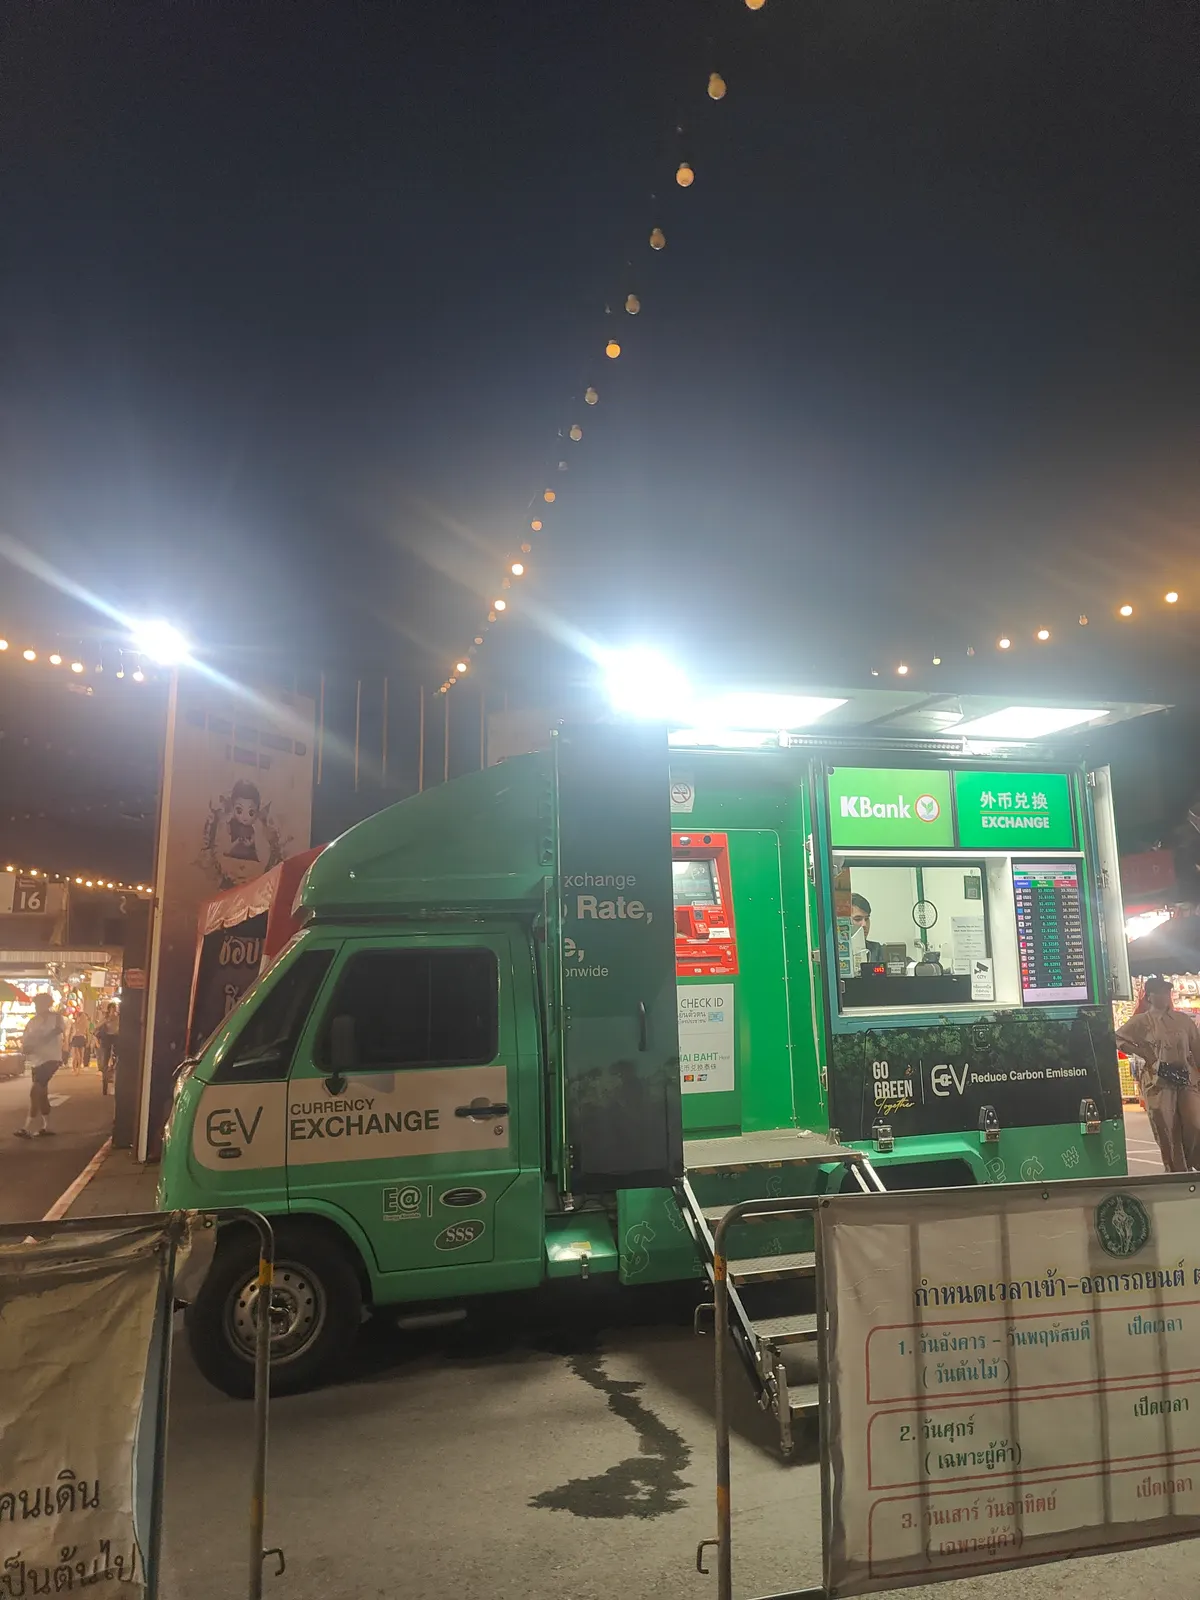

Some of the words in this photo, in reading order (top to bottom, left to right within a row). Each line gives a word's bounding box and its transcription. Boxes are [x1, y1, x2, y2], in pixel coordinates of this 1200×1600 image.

[840, 794, 912, 819] KBank
[979, 791, 1048, 810] 外币兑换
[981, 816, 1049, 829] EXCHANGE
[20, 891, 41, 910] 16
[577, 895, 653, 924] Rate,
[680, 997, 712, 1009] CHECK
[714, 997, 724, 1007] ID
[693, 1052, 718, 1061] BAHT
[873, 1061, 889, 1080] GO
[931, 1063, 969, 1097] EV
[971, 1072, 1007, 1083] Reduce
[1009, 1070, 1044, 1081] Carbon
[1046, 1067, 1087, 1078] Emission
[874, 1079, 913, 1099] GREEN
[290, 1098, 375, 1116] CURRENCY
[206, 1106, 264, 1147] EV
[290, 1109, 440, 1141] EXCHANGE
[445, 1226, 474, 1243] SSS
[898, 1340, 912, 1355] 1.
[918, 1332, 986, 1354] วันอังคาร
[1127, 1315, 1183, 1336] เปิดเวลา
[900, 1425, 916, 1441] 2.
[922, 1414, 975, 1443] วันศุกร์
[1133, 1395, 1189, 1417] เปิดเวลา
[0, 1538, 136, 1597] ป็นต้นไป
